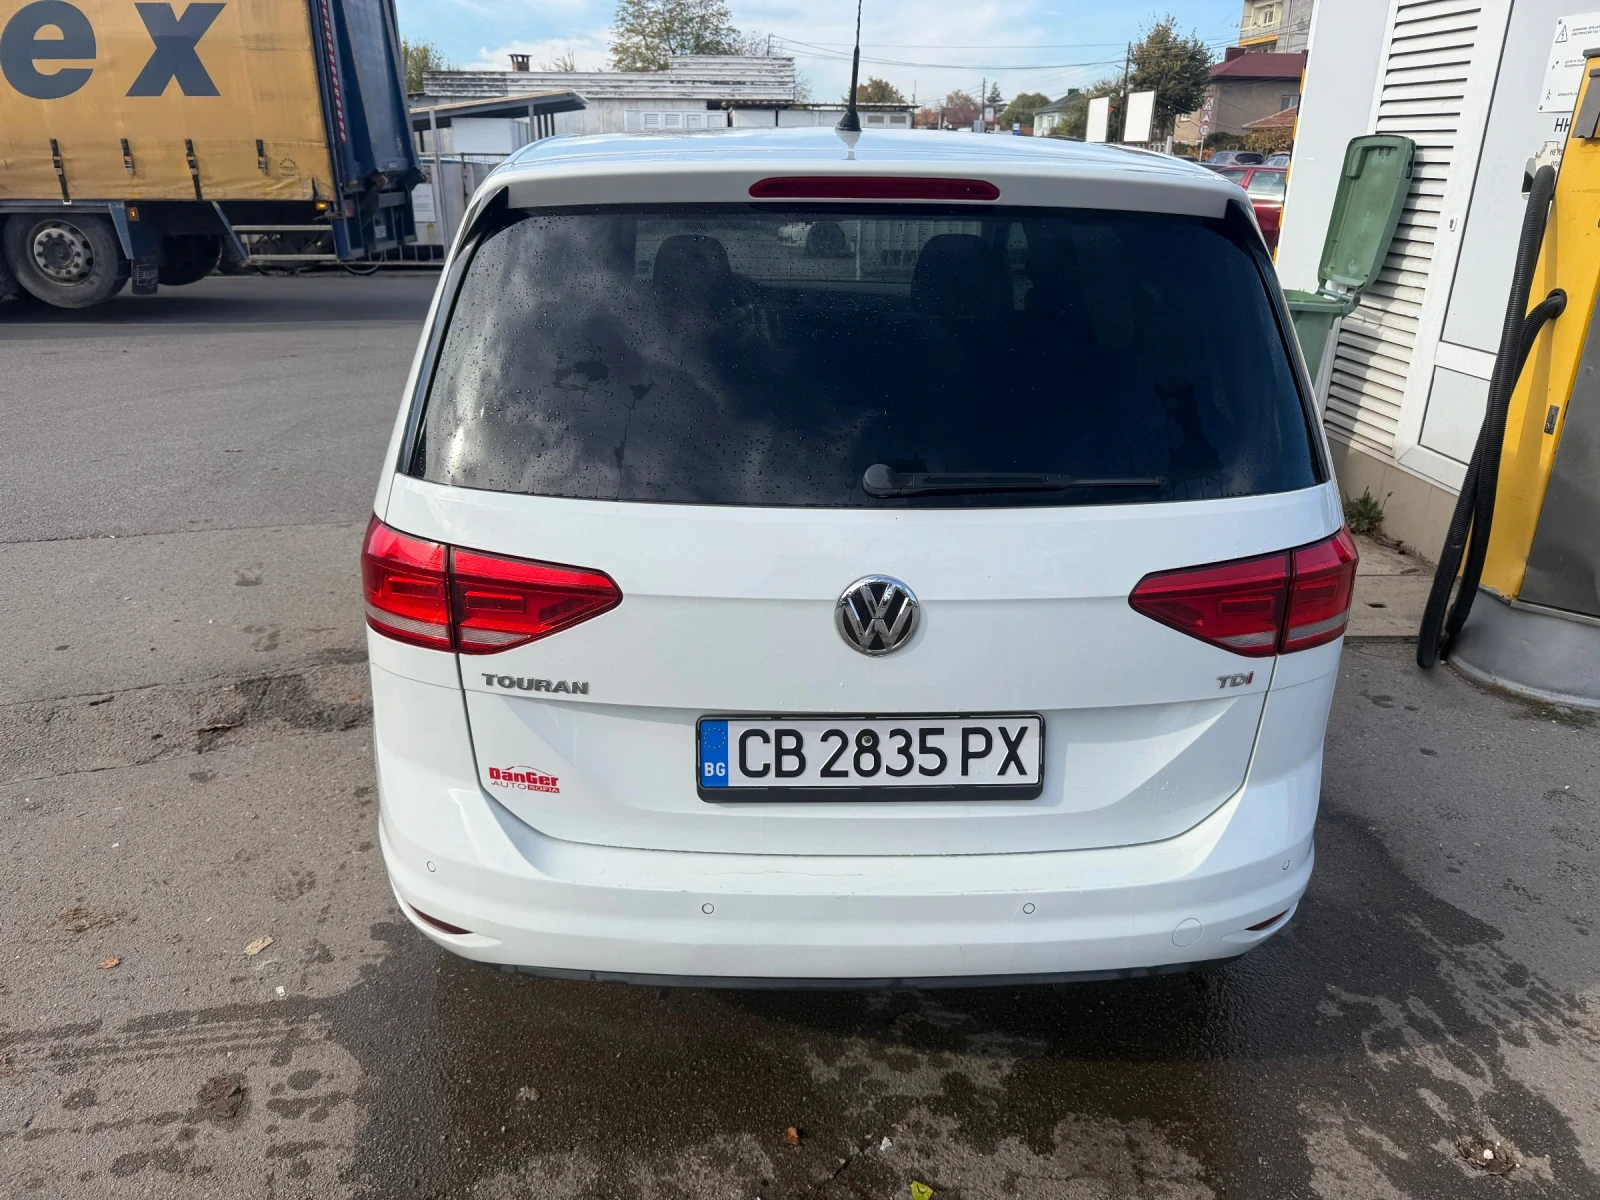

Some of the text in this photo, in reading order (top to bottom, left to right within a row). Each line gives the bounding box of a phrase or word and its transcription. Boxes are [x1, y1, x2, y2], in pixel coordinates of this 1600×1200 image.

[481, 672, 590, 695] TOURAN
[738, 726, 1029, 778] CB 2835 PX
[488, 766, 559, 787] DanGer
[704, 762, 726, 777] BG
[491, 780, 560, 793] AUTO SOFIA
